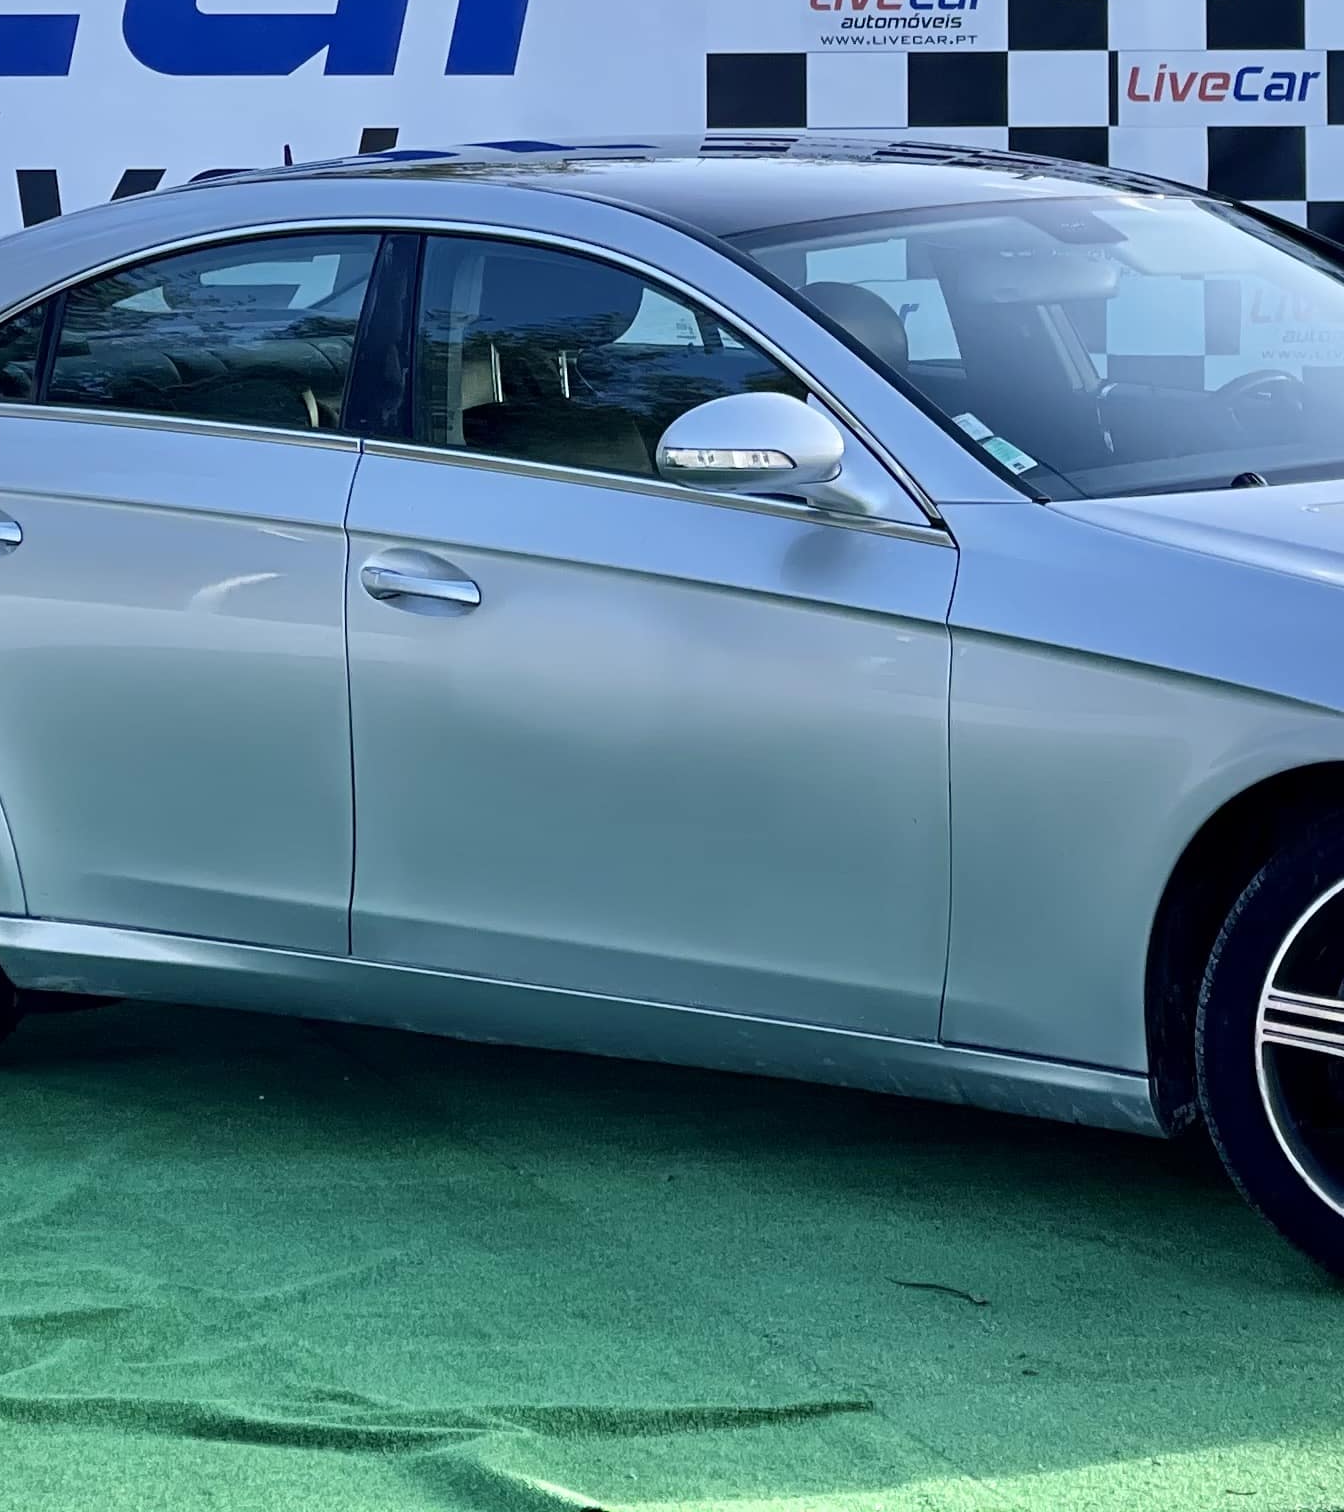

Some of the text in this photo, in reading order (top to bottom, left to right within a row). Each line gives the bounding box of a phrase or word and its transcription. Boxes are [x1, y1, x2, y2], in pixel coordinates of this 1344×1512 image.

[842, 14, 962, 30] automóveis
[821, 35, 978, 45] WWW.LIVECAR.PT
[1127, 64, 1320, 103] LiveCar
